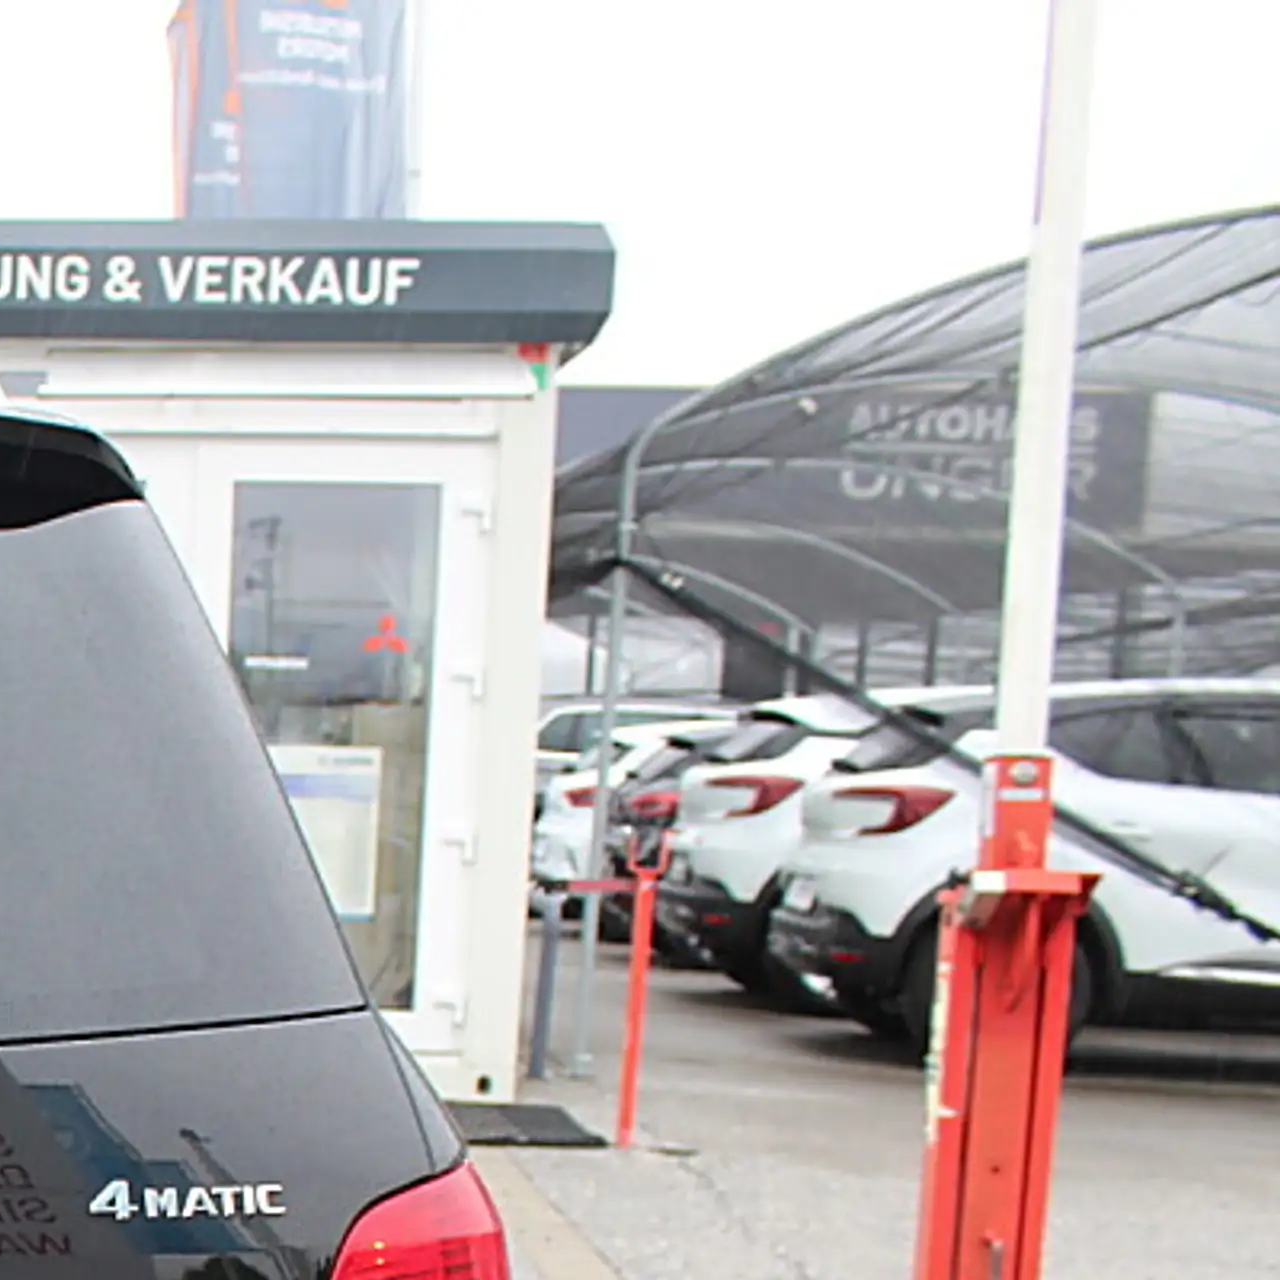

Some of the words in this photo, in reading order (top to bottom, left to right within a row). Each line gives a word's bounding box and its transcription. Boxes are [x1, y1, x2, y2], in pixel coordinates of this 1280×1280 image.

[104, 256, 142, 302] &
[159, 256, 420, 306] VERKAUF
[849, 404, 1101, 443] AUTOHS
[89, 1179, 287, 1221] 4MATIC
